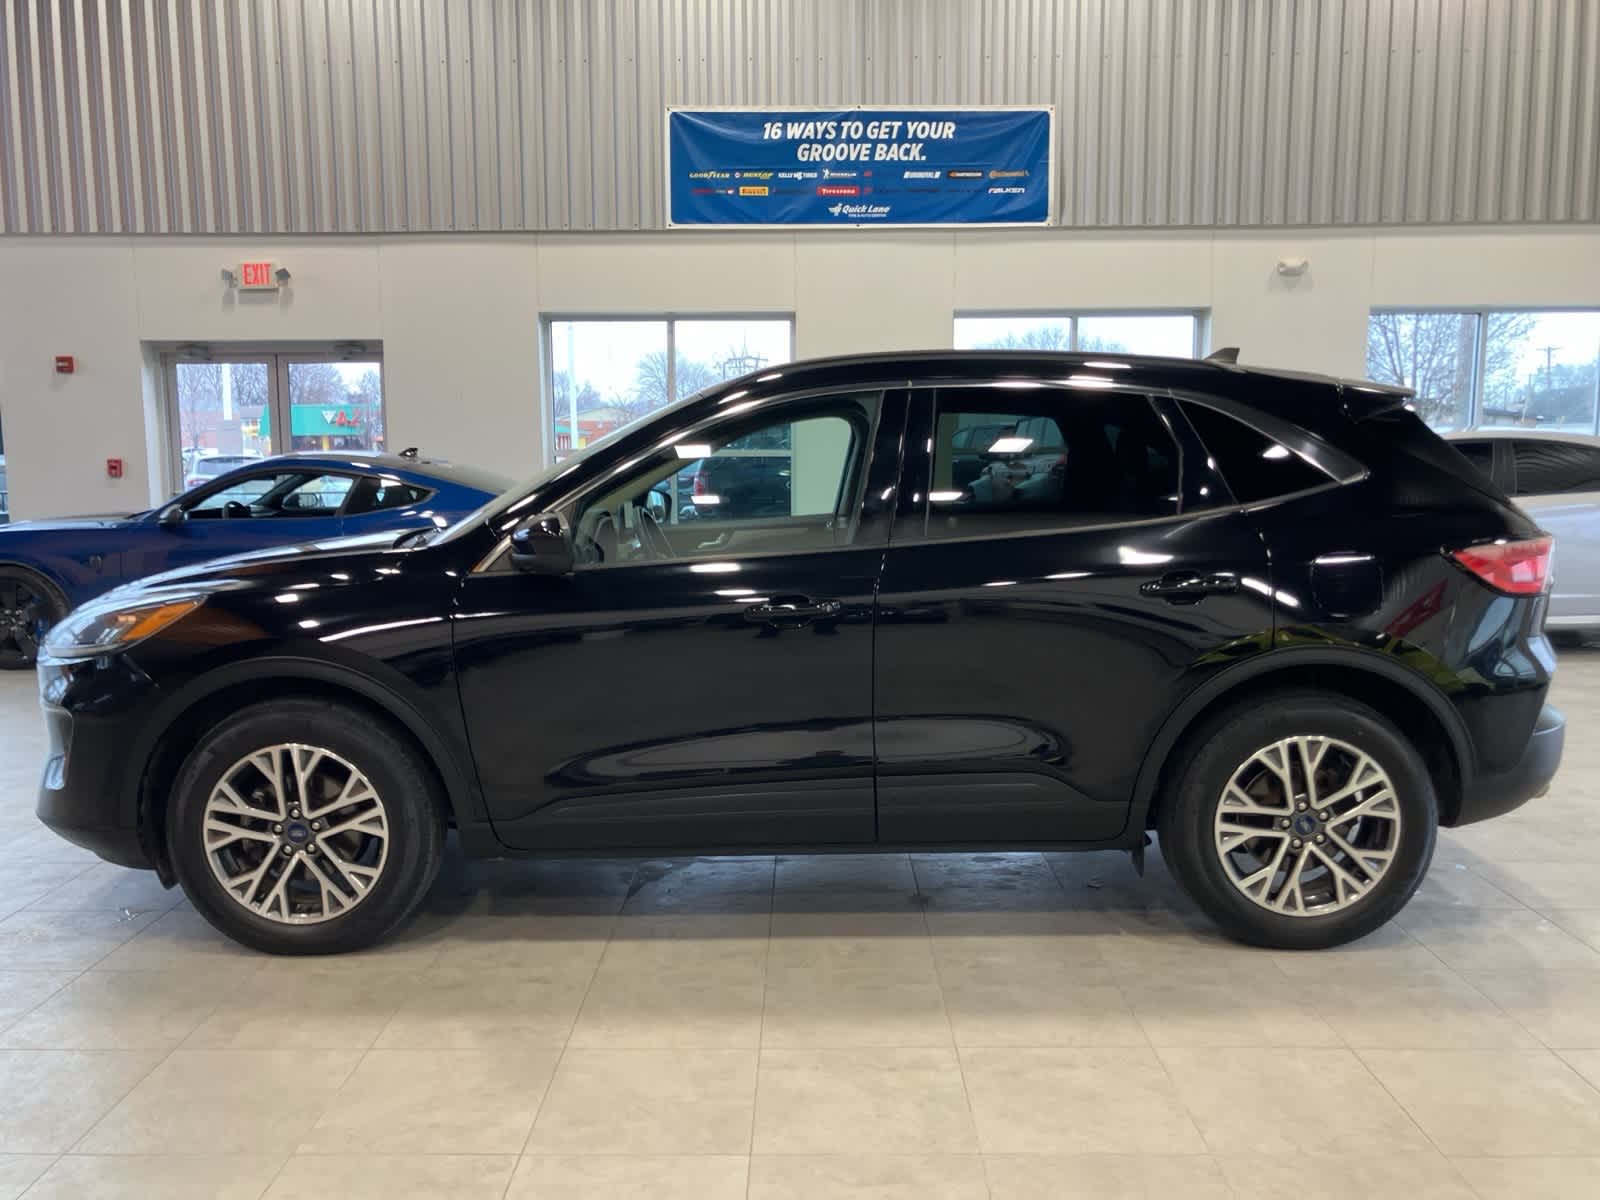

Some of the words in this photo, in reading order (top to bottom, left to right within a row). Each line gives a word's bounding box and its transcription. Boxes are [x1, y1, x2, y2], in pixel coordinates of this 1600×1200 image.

[763, 121, 782, 139] 16
[787, 121, 837, 139] WAYS
[841, 121, 863, 139] TO
[867, 121, 902, 139] GET
[907, 121, 956, 139] YOUR
[797, 143, 872, 161] GROOVE
[875, 143, 927, 161] BACK.
[841, 204, 867, 214] Quick
[867, 204, 890, 213] Lane
[242, 262, 271, 286] EXIT
